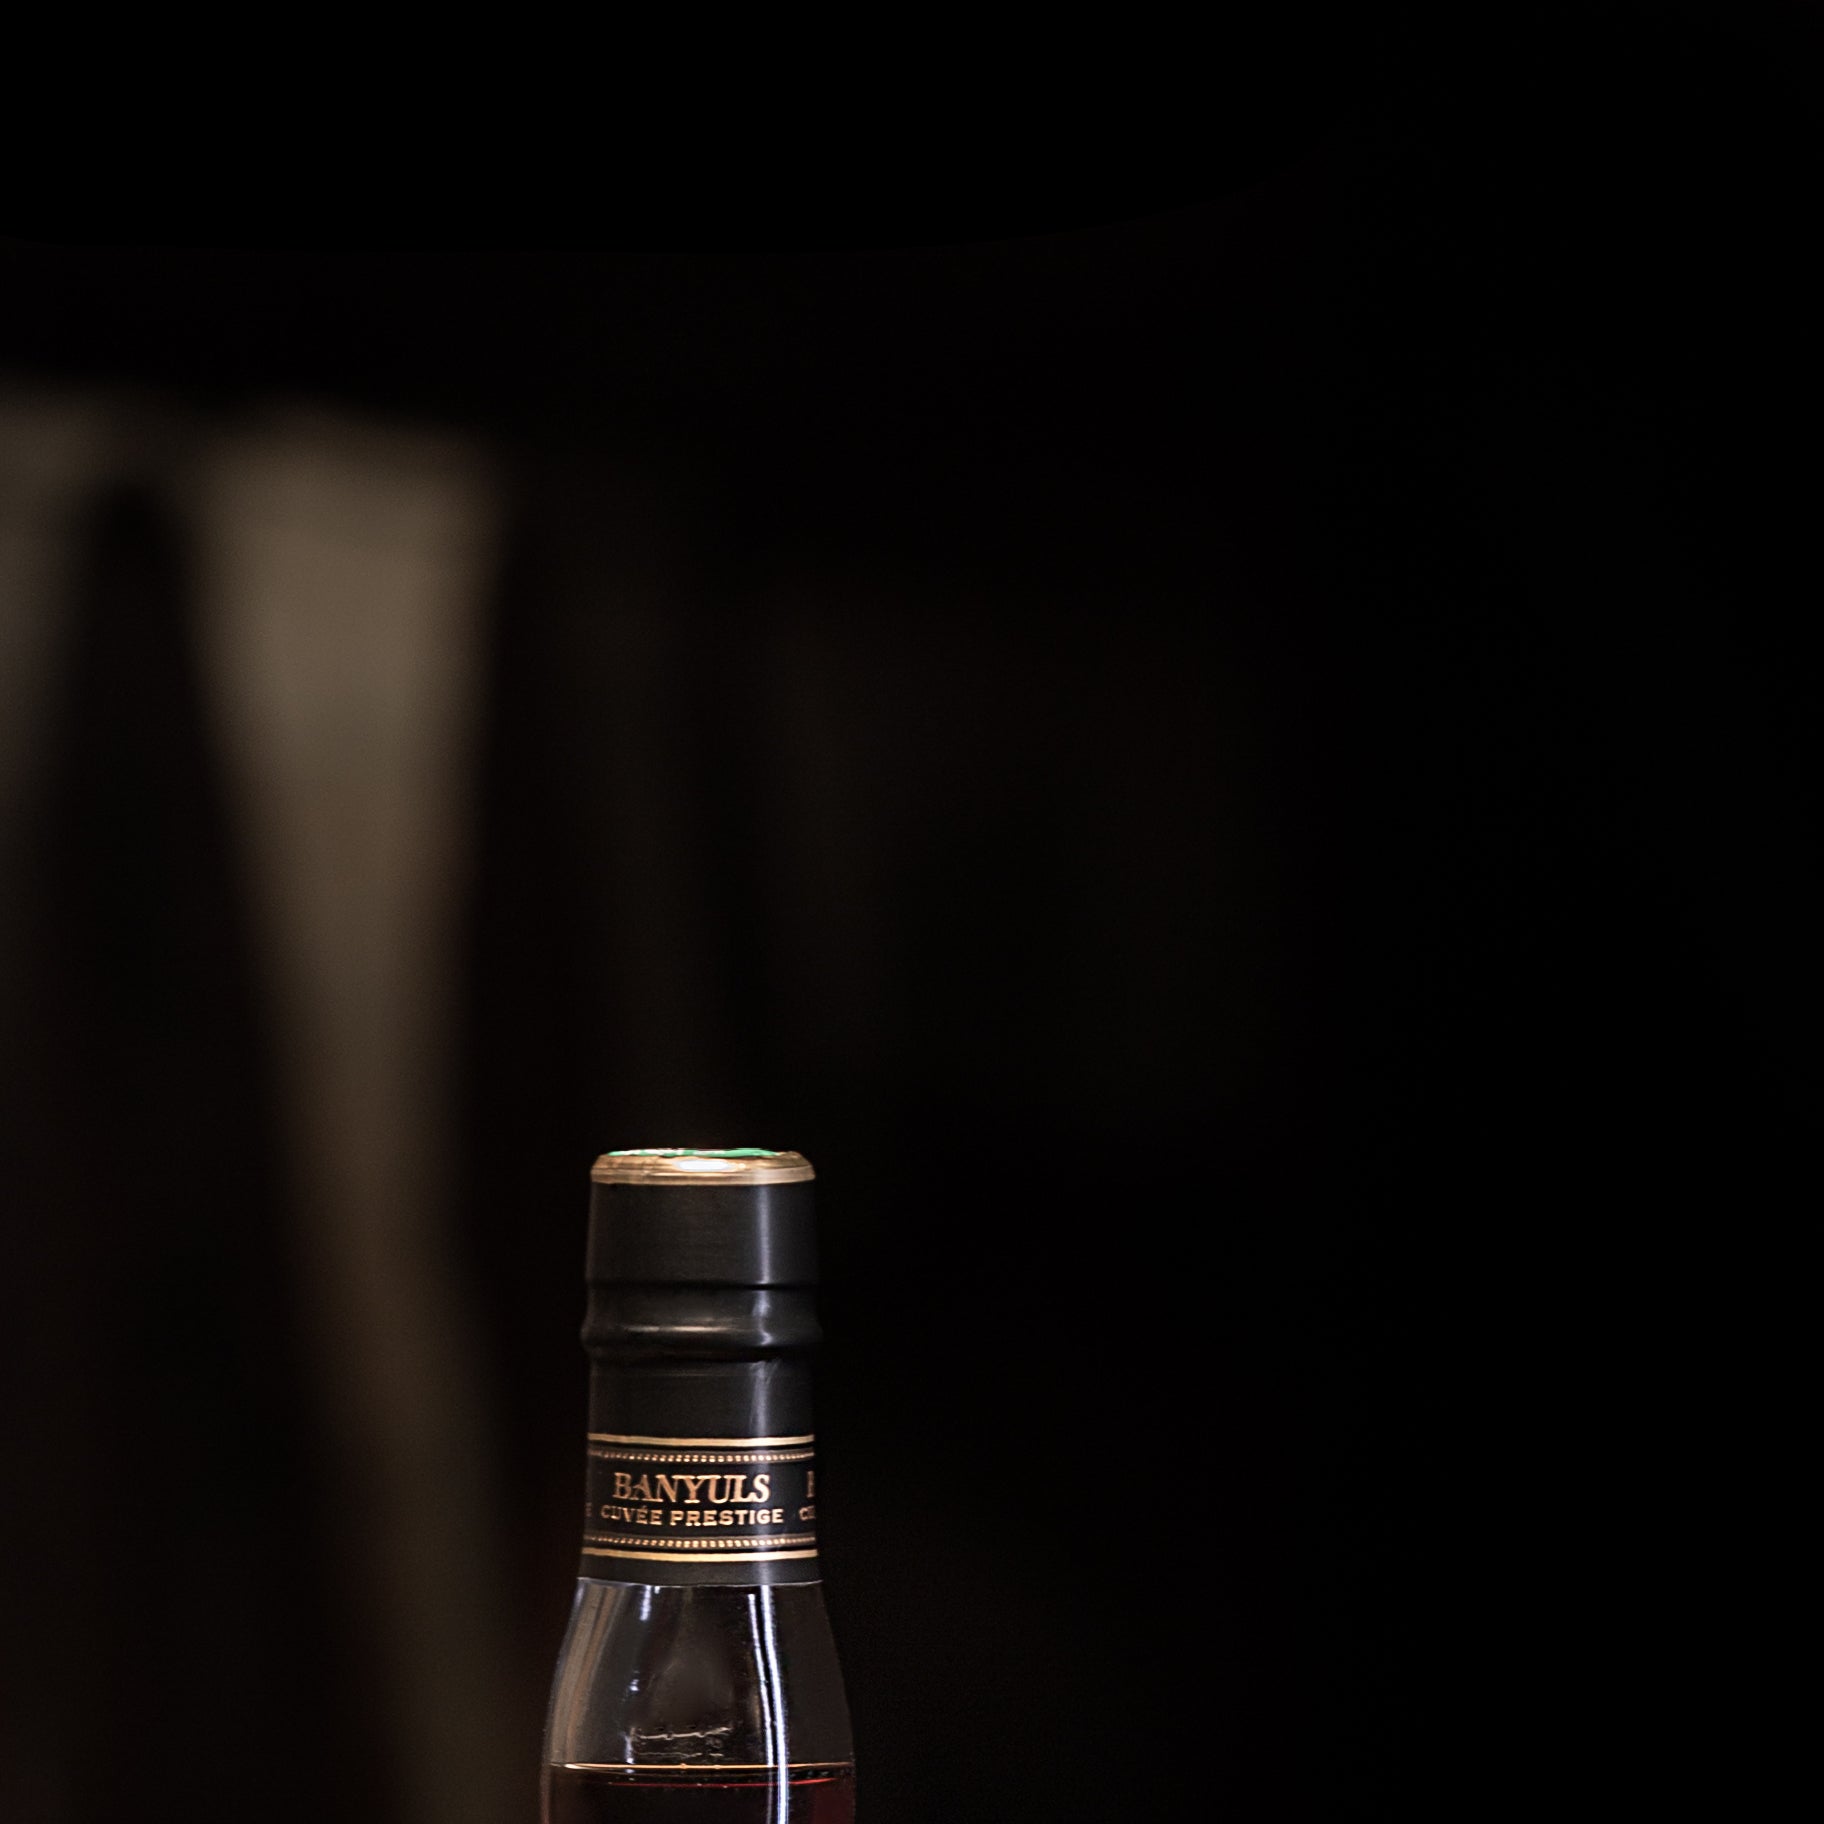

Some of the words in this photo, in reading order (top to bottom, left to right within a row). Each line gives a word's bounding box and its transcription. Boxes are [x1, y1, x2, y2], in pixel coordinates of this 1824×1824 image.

[612, 1471, 772, 1504] BANYULS
[600, 1503, 664, 1526] CUVÉE
[669, 1508, 785, 1527] PRESTIGE
